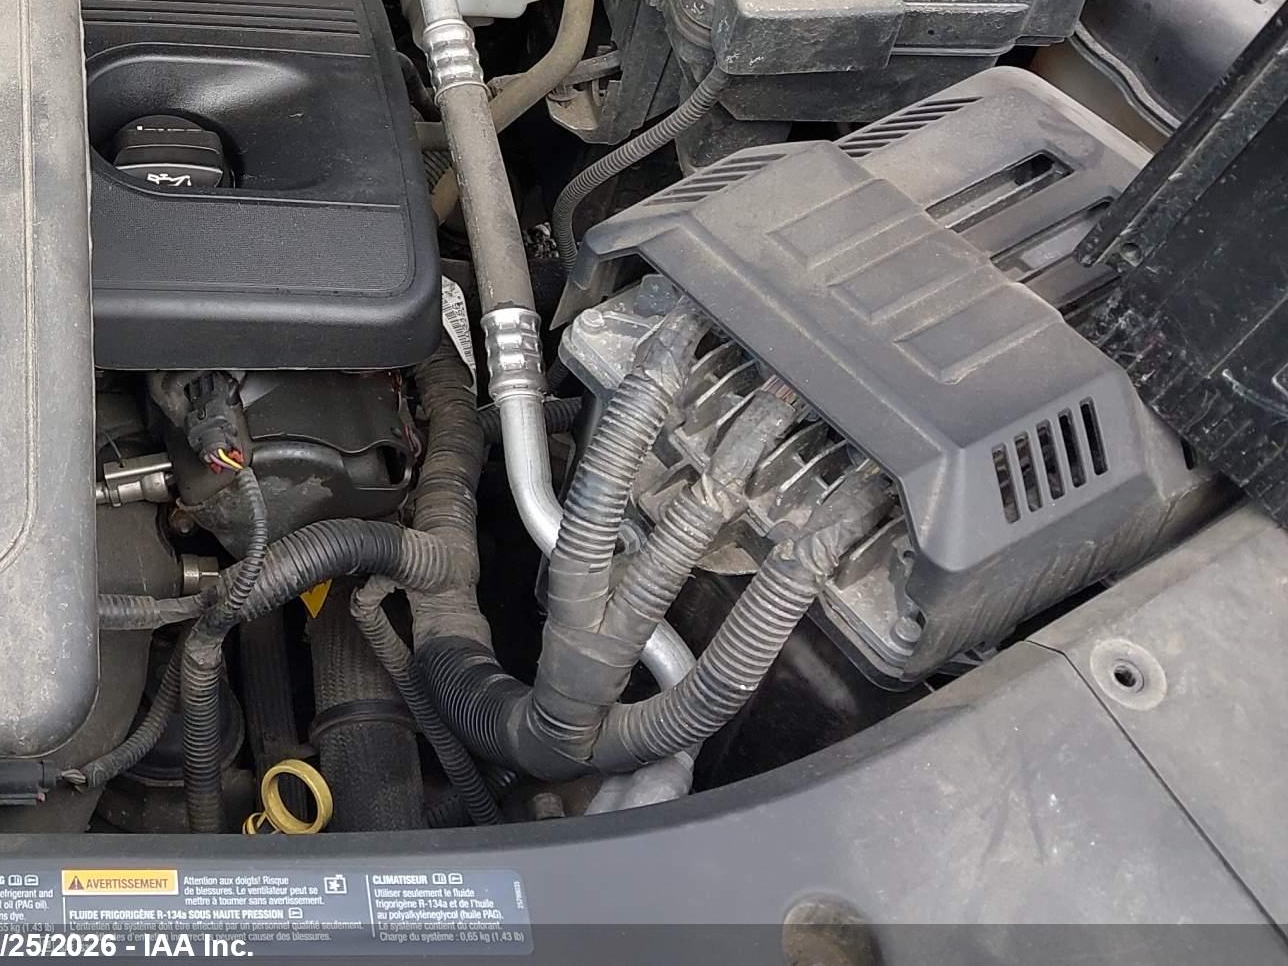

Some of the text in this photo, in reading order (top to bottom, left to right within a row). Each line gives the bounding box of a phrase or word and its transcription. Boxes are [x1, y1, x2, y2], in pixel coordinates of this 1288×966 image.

[86, 879, 168, 889] AVERTISSEMENT
[184, 876, 289, 887] Attention aux doigts! Risque
[372, 875, 428, 884] CLIMATISEUR
[38, 889, 54, 898] and
[184, 886, 318, 896] de blessures. Le ventilateur peut se
[374, 888, 475, 898] Utiliser seulement le fluide
[4, 900, 14, 909] oil
[15, 900, 33, 910] (PAG
[185, 897, 210, 905] mettre
[218, 897, 247, 905] tourner
[268, 897, 325, 905] avertissement.
[418, 899, 448, 908] R-134a
[449, 899, 458, 908] et
[458, 899, 469, 908] de
[470, 899, 494, 908] l'huile
[69, 910, 99, 919] FLUIDE
[157, 910, 187, 919] R-134a
[188, 910, 212, 919] SOUS
[213, 910, 240, 919] HAUTE
[242, 910, 284, 919] PRESSION
[376, 912, 388, 920] au
[460, 910, 482, 921] (huile
[482, 910, 504, 920] PAG).
[10, 923, 20, 933] kg
[22, 923, 43, 933] (1.43
[44, 923, 55, 933] lb)
[70, 921, 110, 931] L'entretien
[112, 922, 122, 930] du
[124, 921, 156, 932] système
[158, 922, 171, 930] doit
[192, 920, 224, 930] effectué
[225, 922, 238, 932] par
[240, 922, 250, 930] un
[252, 921, 290, 932] personnel
[322, 920, 364, 930] seulement.
[378, 922, 502, 932] Le système contient du colorant.
[248, 933, 274, 941] causer
[276, 932, 290, 941] des
[292, 932, 332, 941] blessures.
[380, 932, 408, 943] Charge
[409, 932, 420, 941] du
[421, 932, 454, 943] système
[480, 932, 490, 943] kg
[514, 932, 524, 943] lb)
